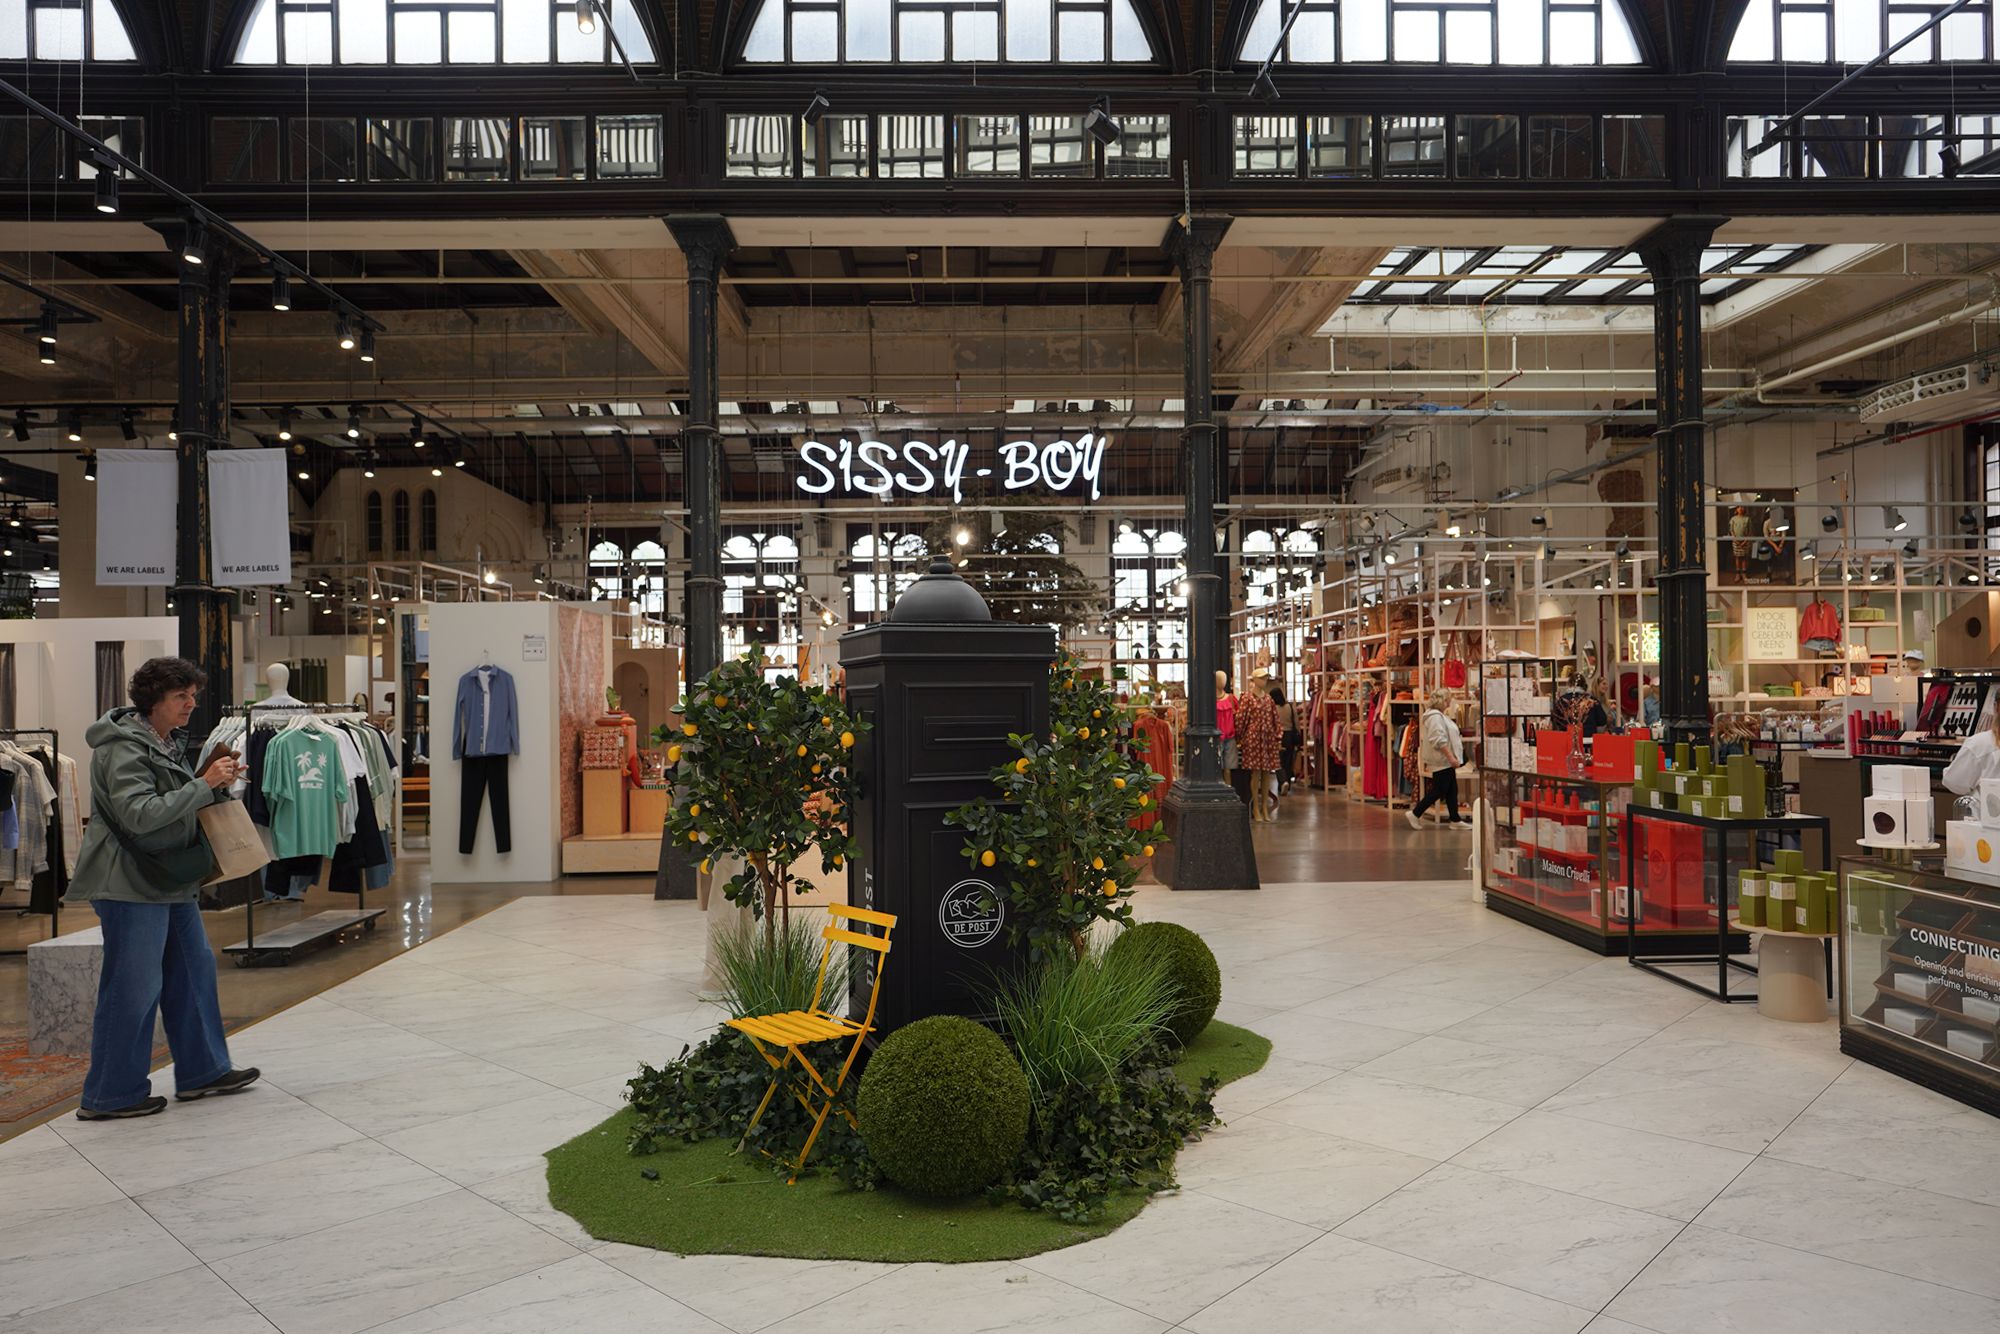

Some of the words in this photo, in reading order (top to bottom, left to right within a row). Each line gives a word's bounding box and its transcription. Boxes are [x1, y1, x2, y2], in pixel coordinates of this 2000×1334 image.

[106, 566, 119, 574] WE
[120, 566, 135, 574] ARE
[137, 566, 165, 575] LABELS
[222, 565, 235, 573] WE
[235, 565, 250, 573] ARE
[252, 564, 280, 572] LABELS
[1542, 859, 1565, 876] Maison
[1566, 866, 1590, 883] Crivelli
[954, 923, 965, 933] DE
[968, 922, 990, 932] POST
[1910, 928, 2000, 961] CONNECTING
[1914, 956, 1947, 975] Opening
[1949, 967, 1963, 977] and
[1928, 975, 1963, 992] perfume,
[1965, 983, 1991, 1001] home,
